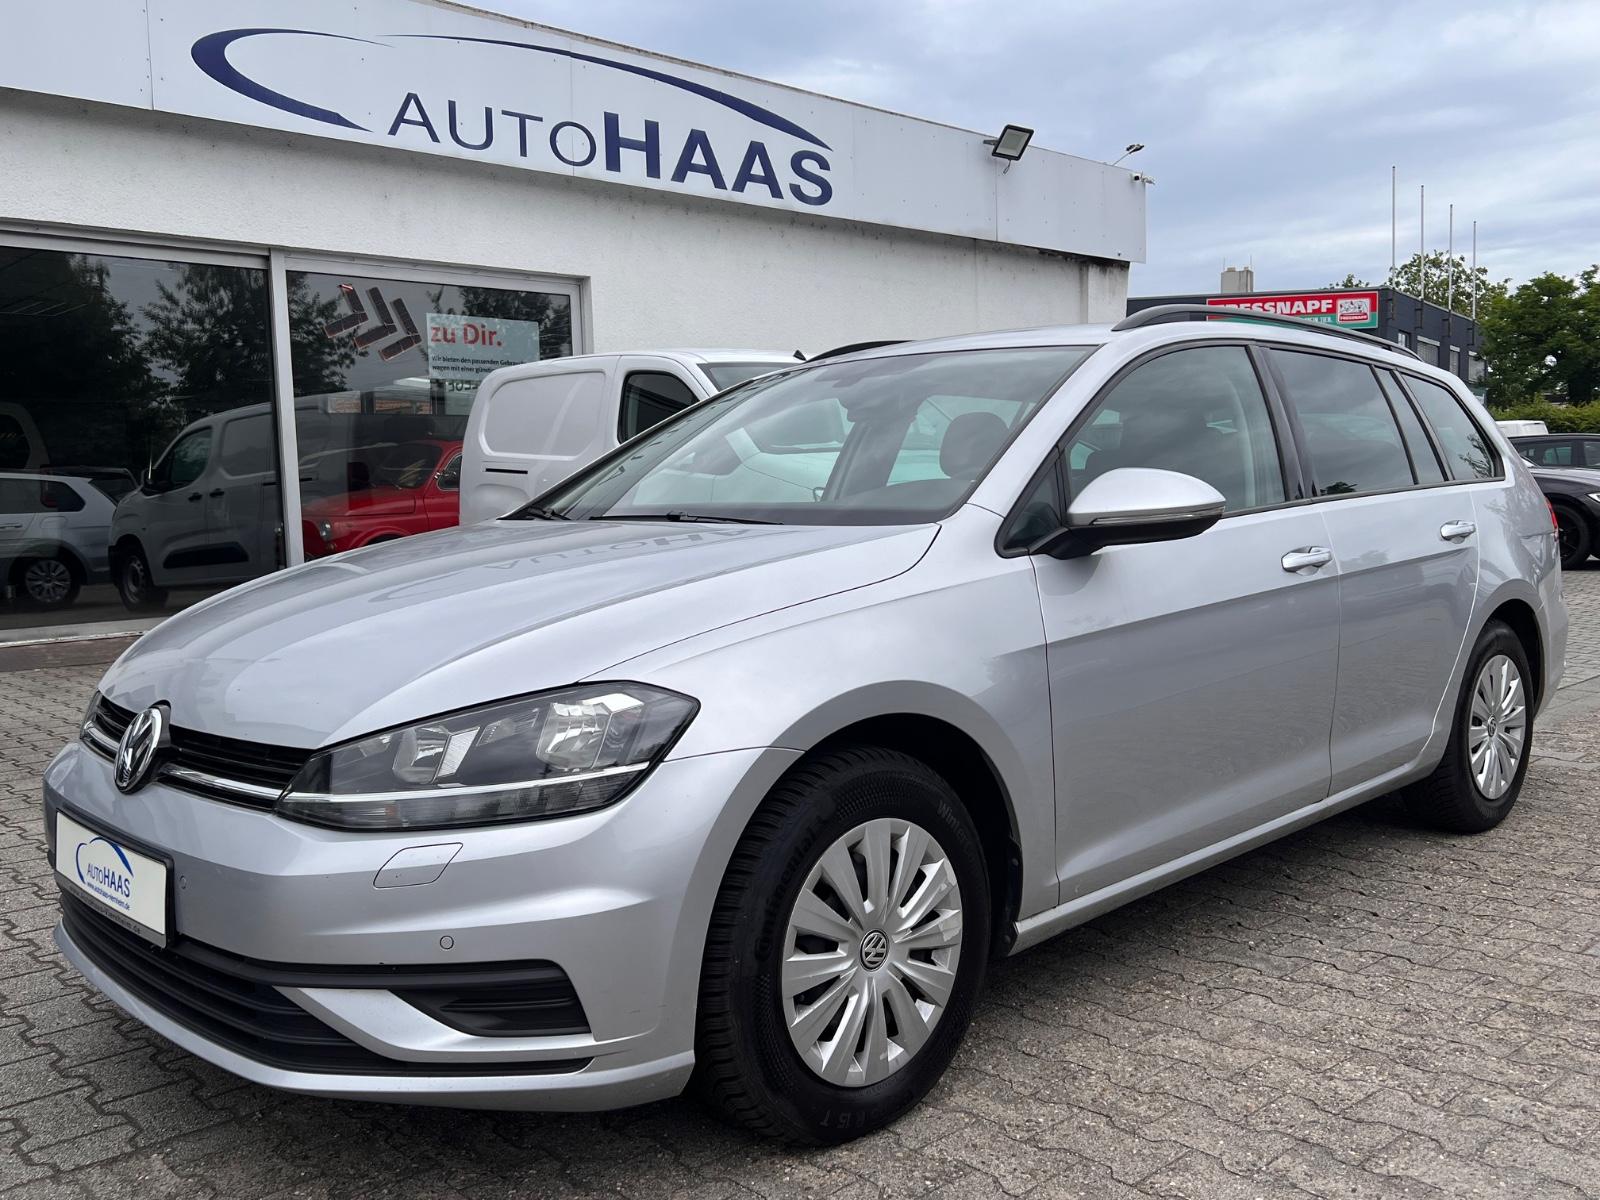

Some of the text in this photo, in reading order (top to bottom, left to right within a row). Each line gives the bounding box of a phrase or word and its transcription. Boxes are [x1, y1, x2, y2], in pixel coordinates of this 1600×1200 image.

[387, 92, 833, 207] AUTOHAAS
[431, 323, 503, 346] zu Dir.
